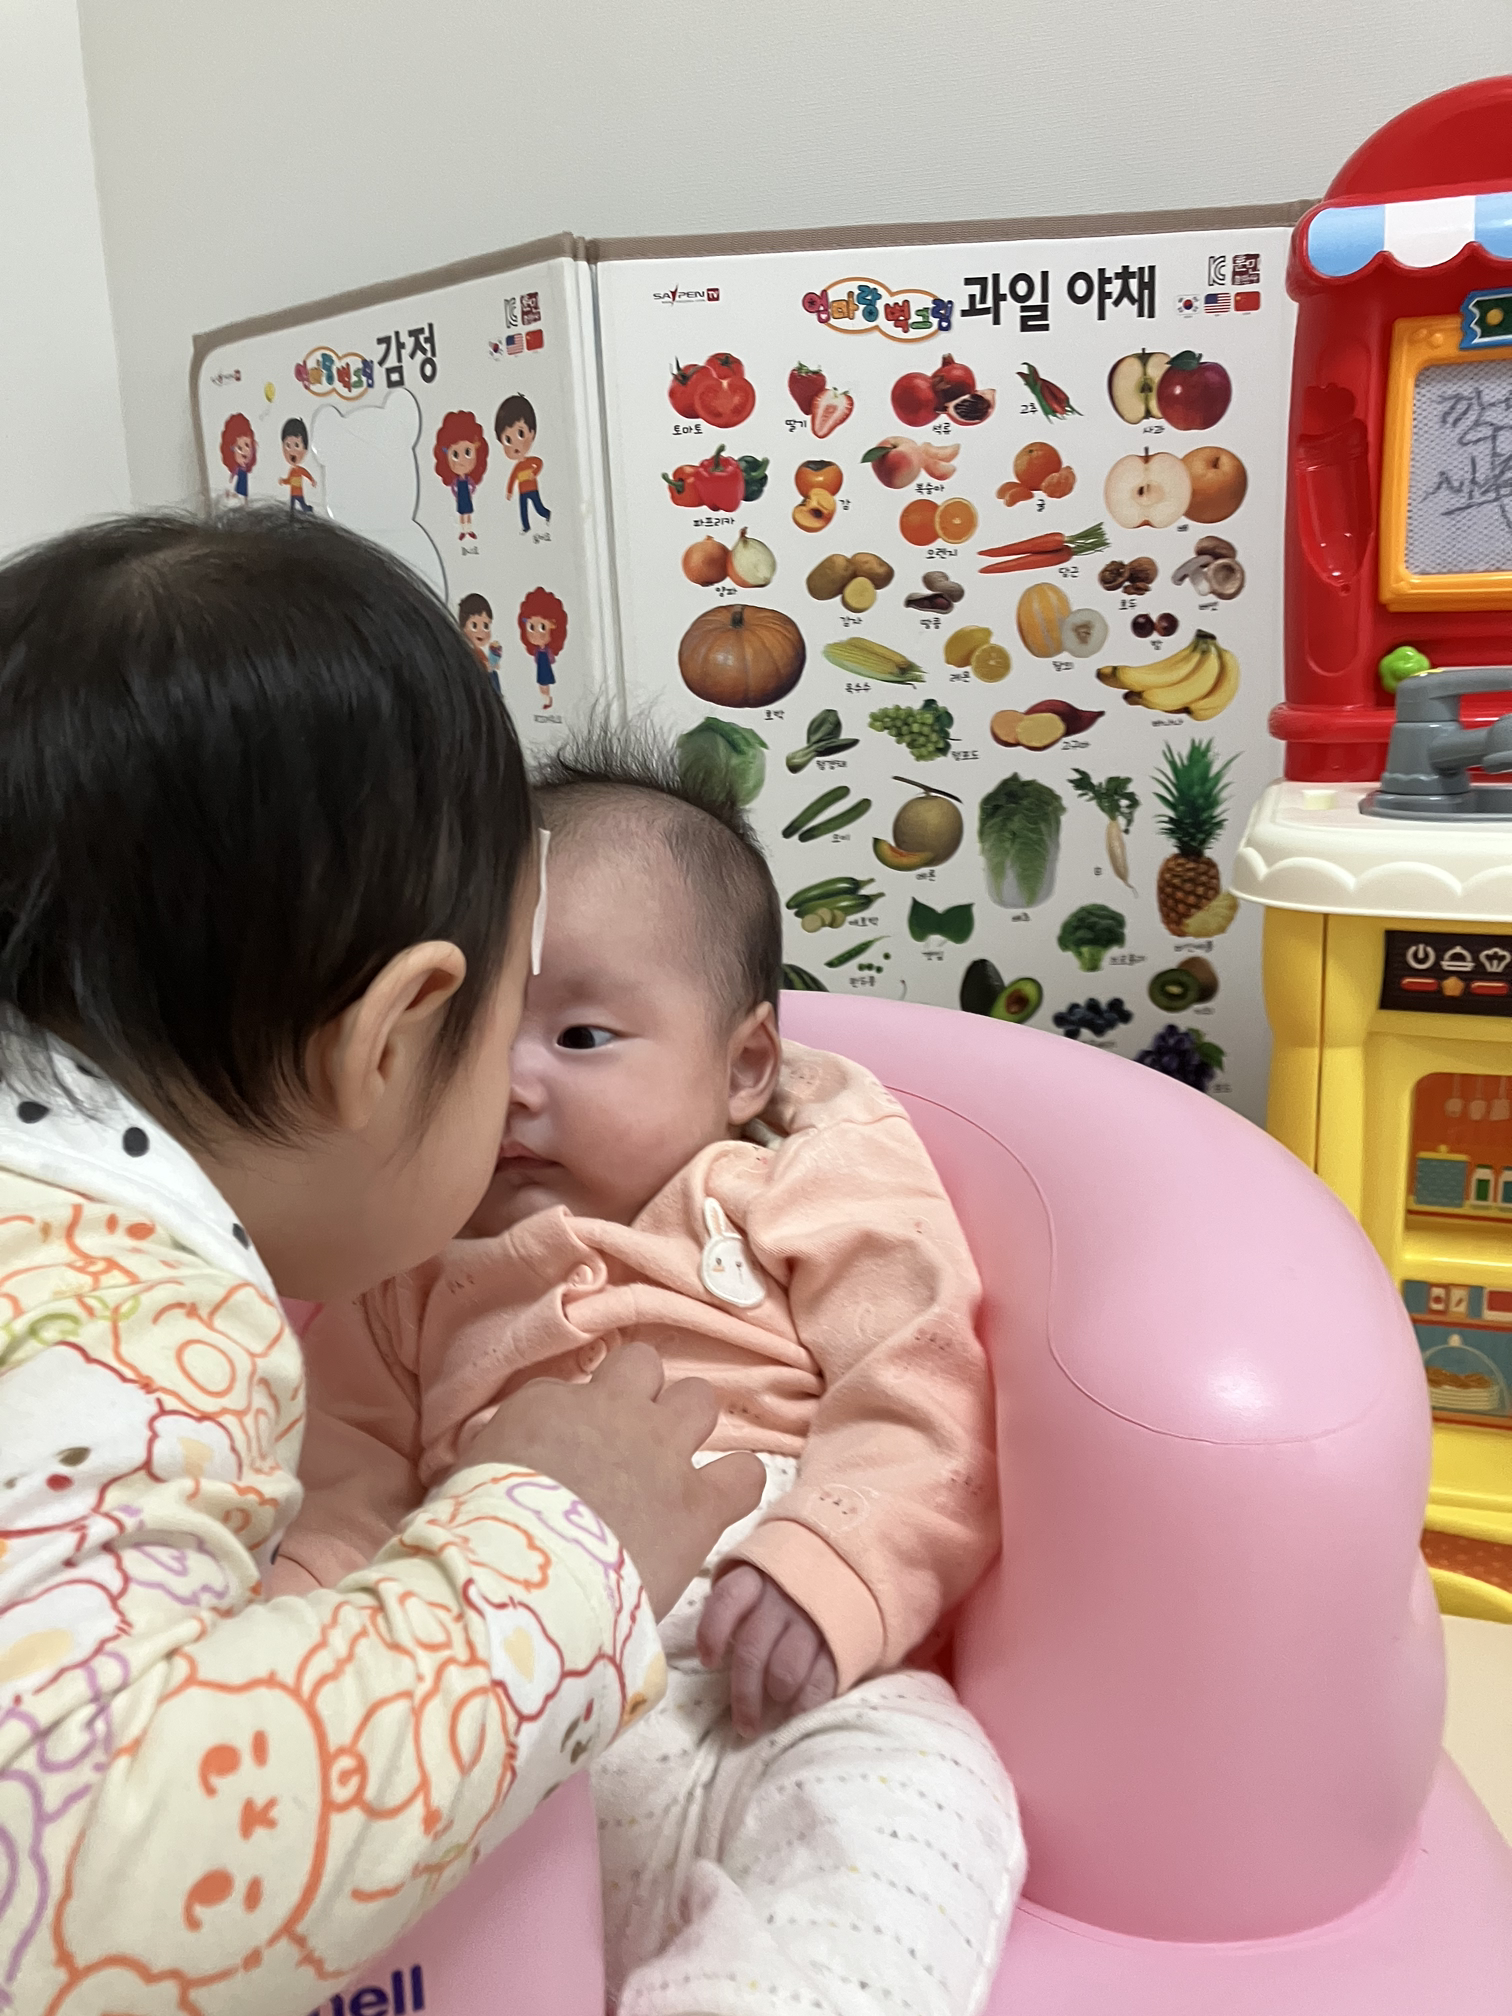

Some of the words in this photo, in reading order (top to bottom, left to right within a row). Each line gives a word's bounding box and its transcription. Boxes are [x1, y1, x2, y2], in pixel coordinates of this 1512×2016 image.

[653, 285, 705, 305] SAYPEN
[707, 288, 719, 300] TV
[961, 271, 1050, 332] 과일
[1067, 265, 1156, 320] 야채
[802, 285, 881, 323] 엄마랑
[885, 299, 953, 333] 벽그림
[376, 322, 437, 388] 감정
[1020, 402, 1040, 414] 고추
[672, 424, 703, 435] 토마토
[785, 419, 807, 432] 딸기
[930, 422, 951, 435] 석류
[1143, 426, 1165, 434] 사과
[915, 483, 945, 495] 복숭아
[840, 499, 851, 510] 감
[1036, 499, 1045, 512] 귤
[693, 517, 735, 527] 파프리카
[926, 548, 957, 559] 오렌지
[1058, 566, 1079, 578] 당근
[715, 586, 737, 597] 양파
[1119, 599, 1137, 610] 호두
[839, 617, 862, 627] 감자
[920, 617, 941, 629] 땅콩
[1052, 661, 1074, 672] 참외
[949, 671, 970, 682] 레몬
[845, 682, 871, 694] 옥수수
[764, 710, 785, 720] 호박
[1151, 719, 1184, 727] 바나나
[1060, 740, 1091, 750] 고구마
[951, 750, 979, 761] 청포도
[816, 760, 847, 770] 청경채
[831, 834, 850, 843] 오이
[914, 868, 936, 881] 멜론
[847, 916, 879, 927] 애호박
